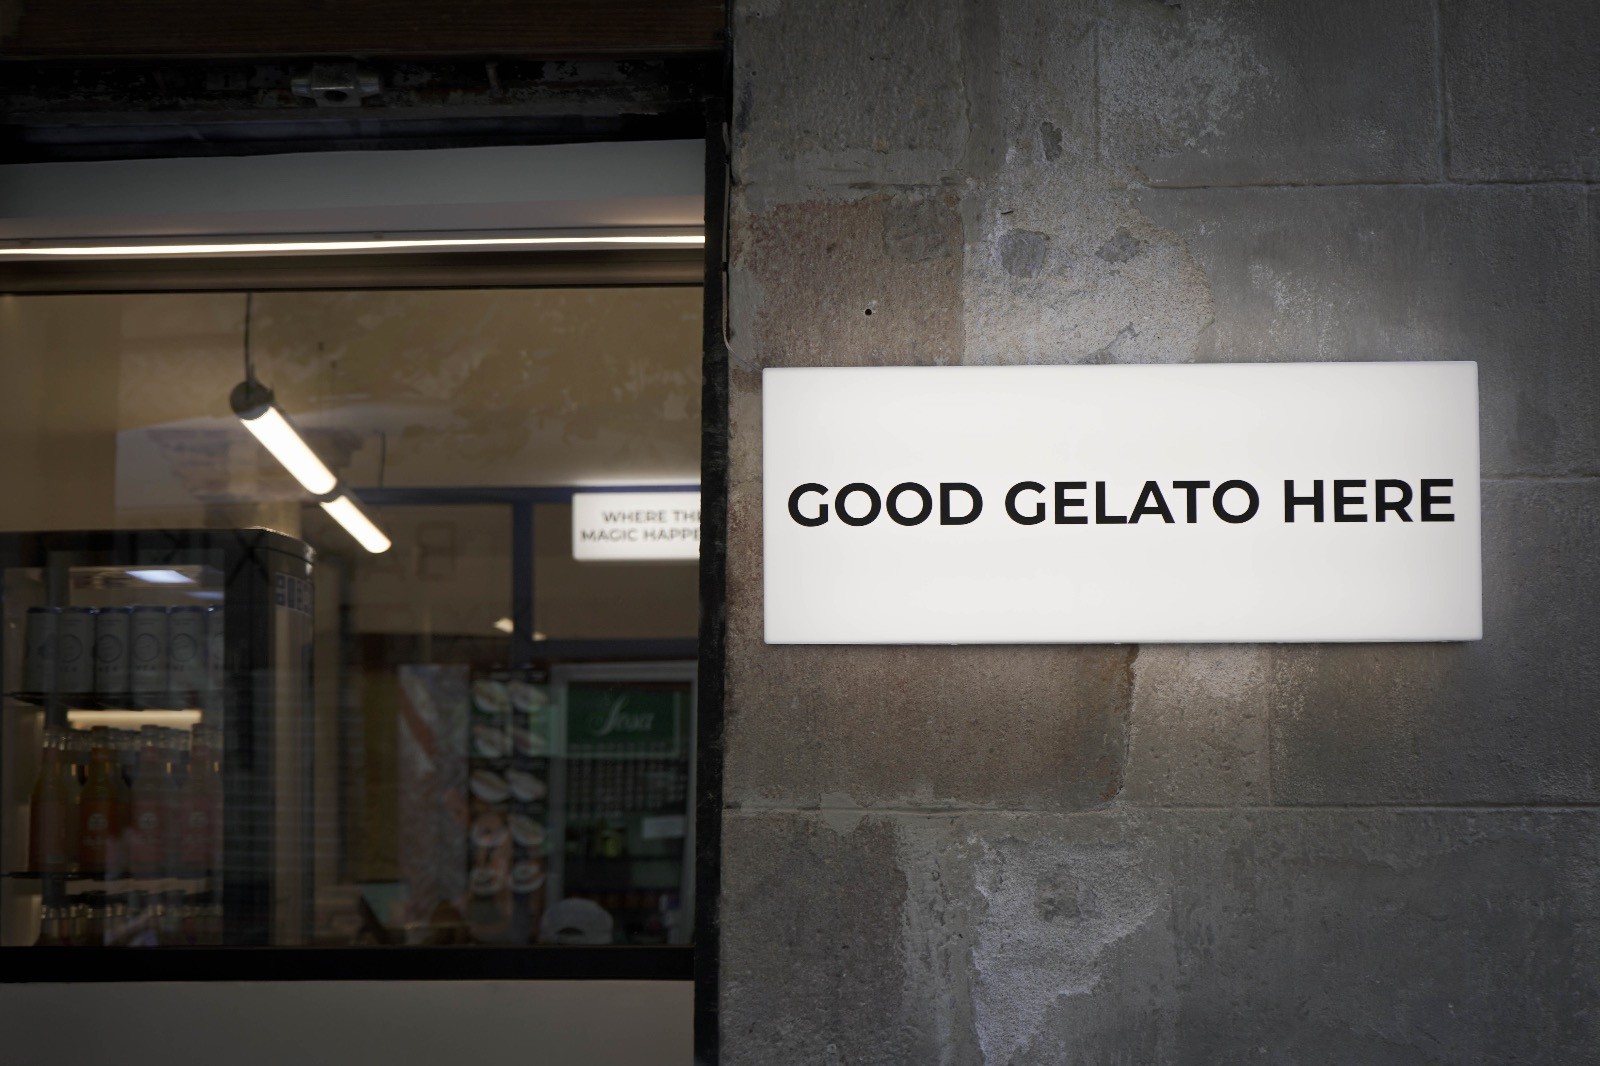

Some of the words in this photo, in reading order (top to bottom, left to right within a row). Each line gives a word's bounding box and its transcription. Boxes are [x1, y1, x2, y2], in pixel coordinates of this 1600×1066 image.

[787, 481, 983, 528] GOOD
[1004, 479, 1260, 526] GELATO
[1284, 478, 1455, 523] HERE
[602, 510, 667, 524] WHERE
[581, 528, 638, 542] MAGIC
